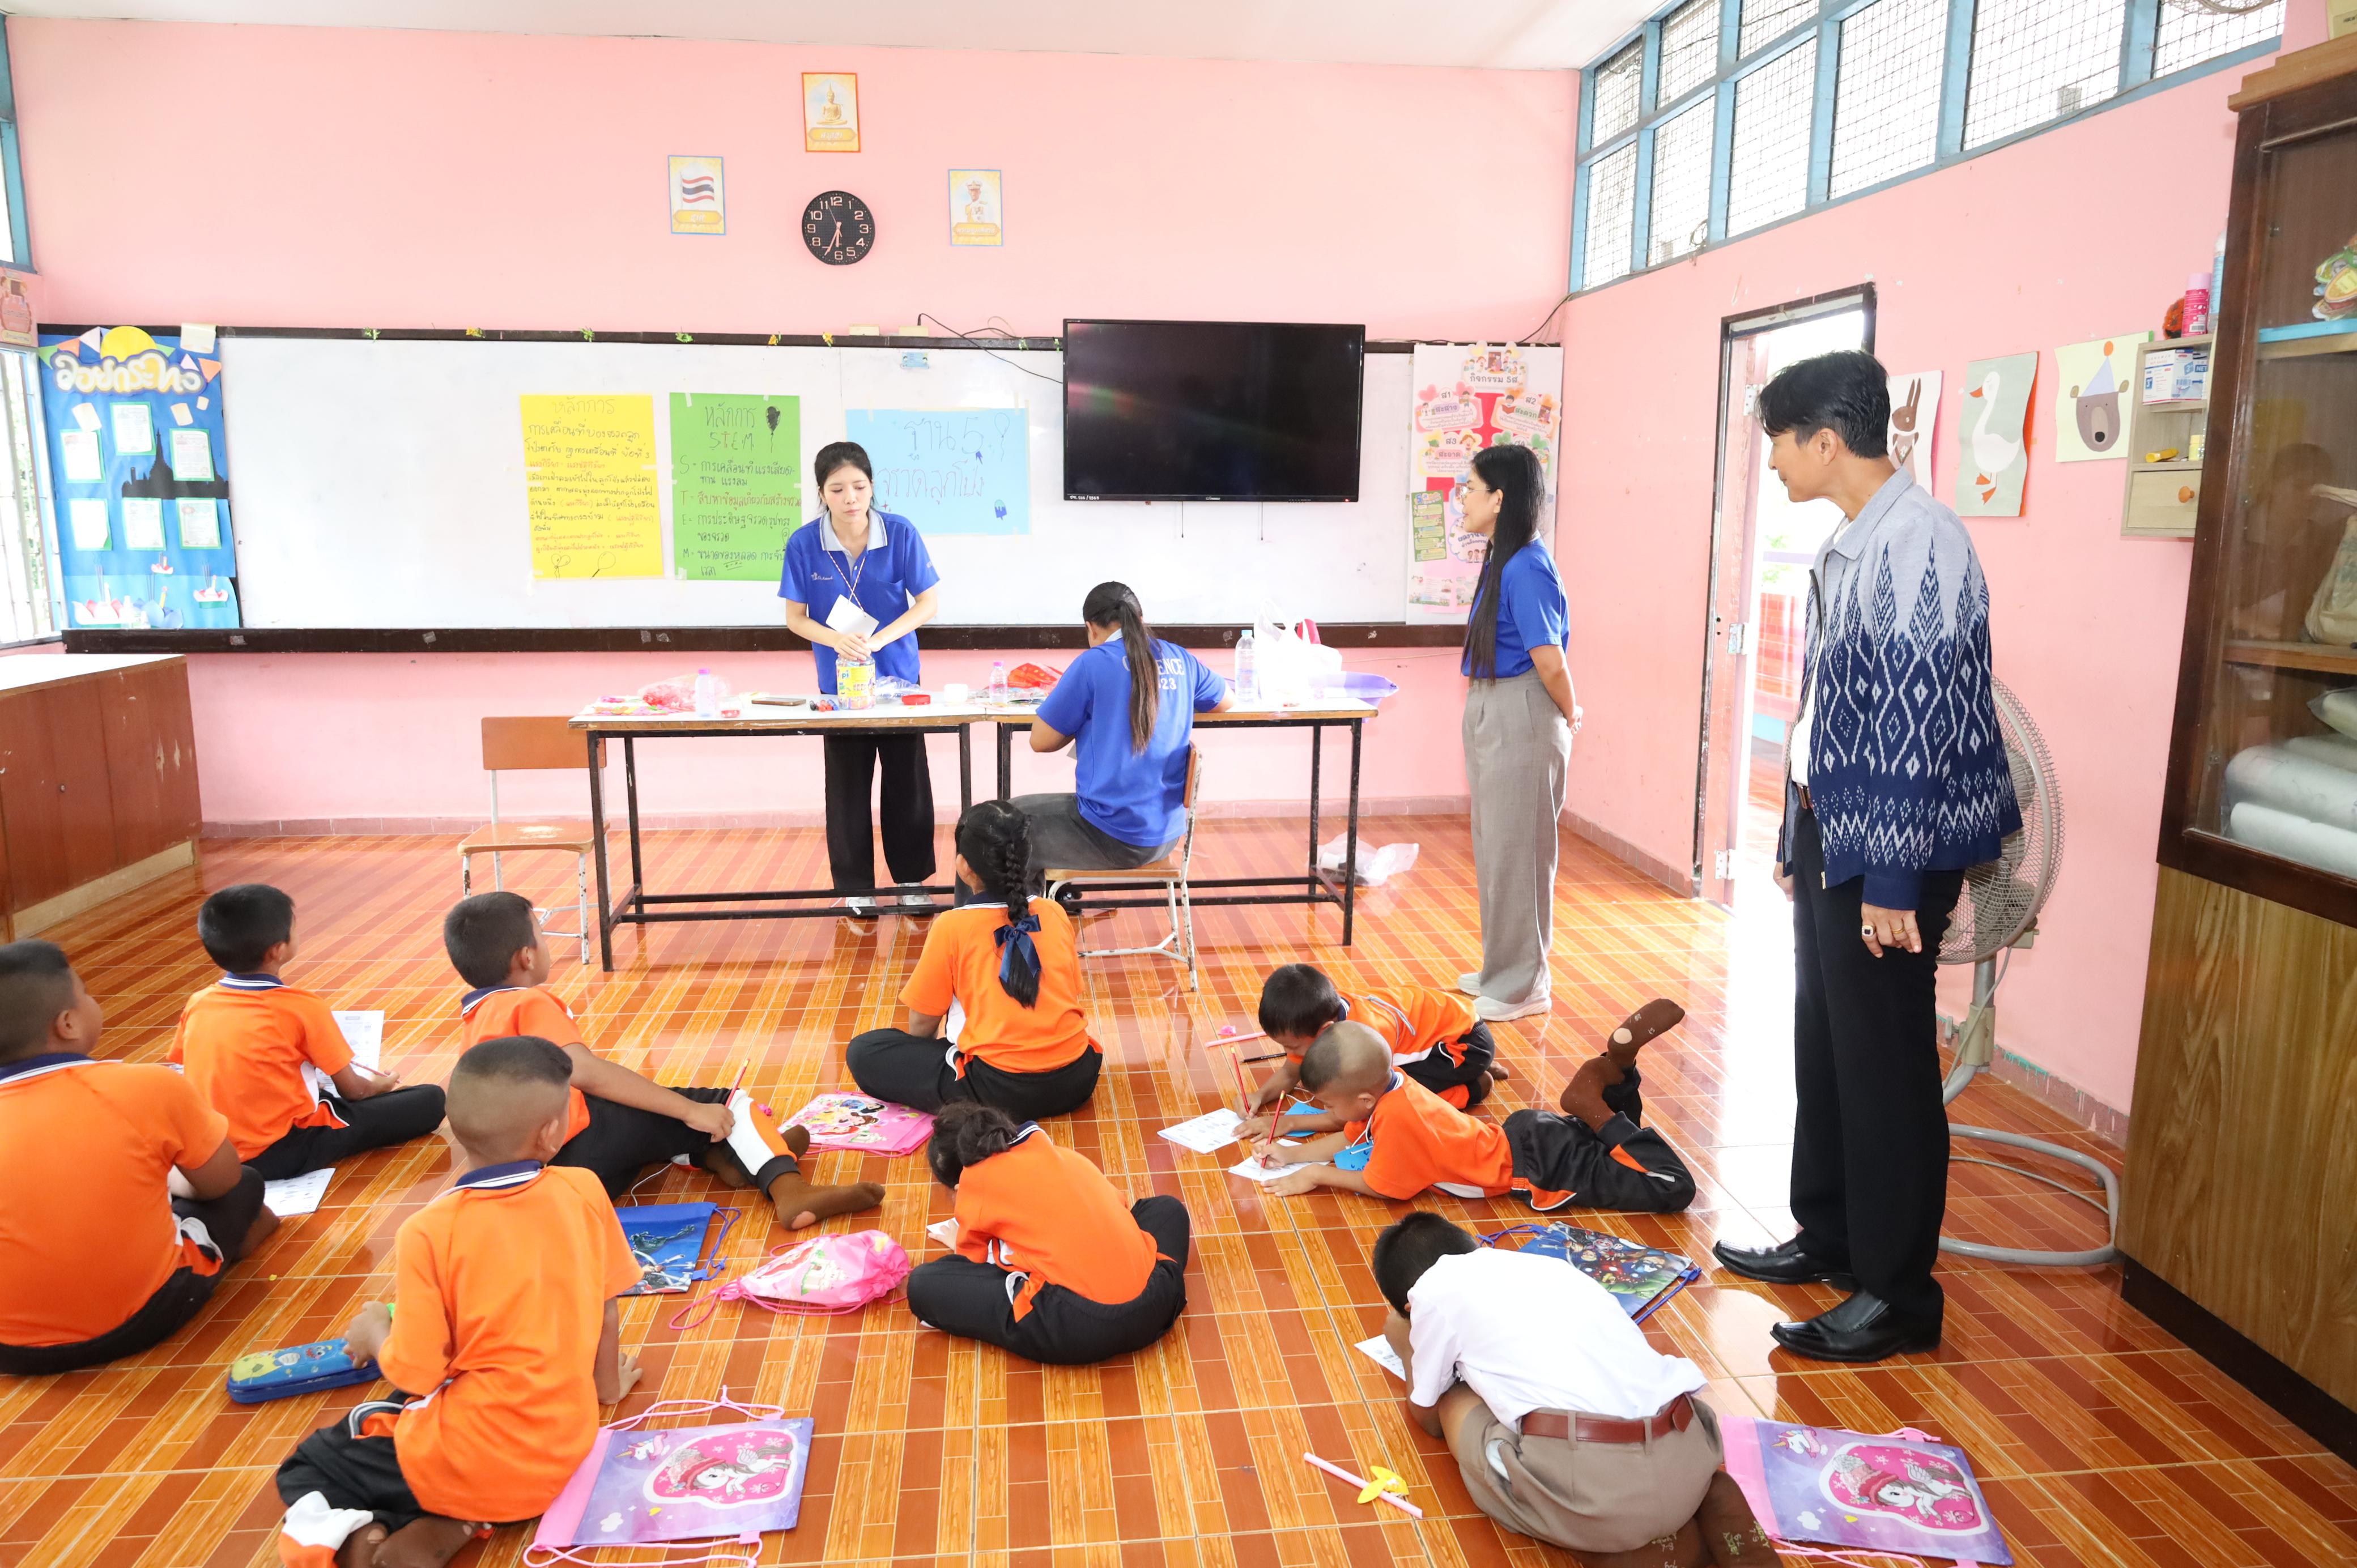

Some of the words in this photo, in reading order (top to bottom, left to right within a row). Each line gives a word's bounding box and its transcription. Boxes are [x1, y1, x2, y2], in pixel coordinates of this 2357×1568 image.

[820, 201, 828, 210] 11
[830, 196, 843, 206] 12
[848, 201, 852, 209] 1
[810, 211, 822, 220] 10
[854, 211, 864, 220] 2
[807, 224, 816, 233] 9
[860, 224, 869, 233] 3
[812, 237, 820, 246] 8
[856, 238, 865, 246] 4
[822, 246, 830, 255] 7
[846, 247, 855, 256] 5
[835, 251, 843, 260] 6
[1470, 372, 1503, 382] กิจกรรม
[551, 396, 616, 415] หลักการ
[1515, 407, 1537, 419] สะดวก
[962, 416, 984, 454] 5
[680, 455, 690, 474] S
[877, 459, 984, 505] จรวดลูกโป่ง
[680, 491, 688, 506] T
[682, 514, 687, 525] E
[683, 548, 690, 559] M
